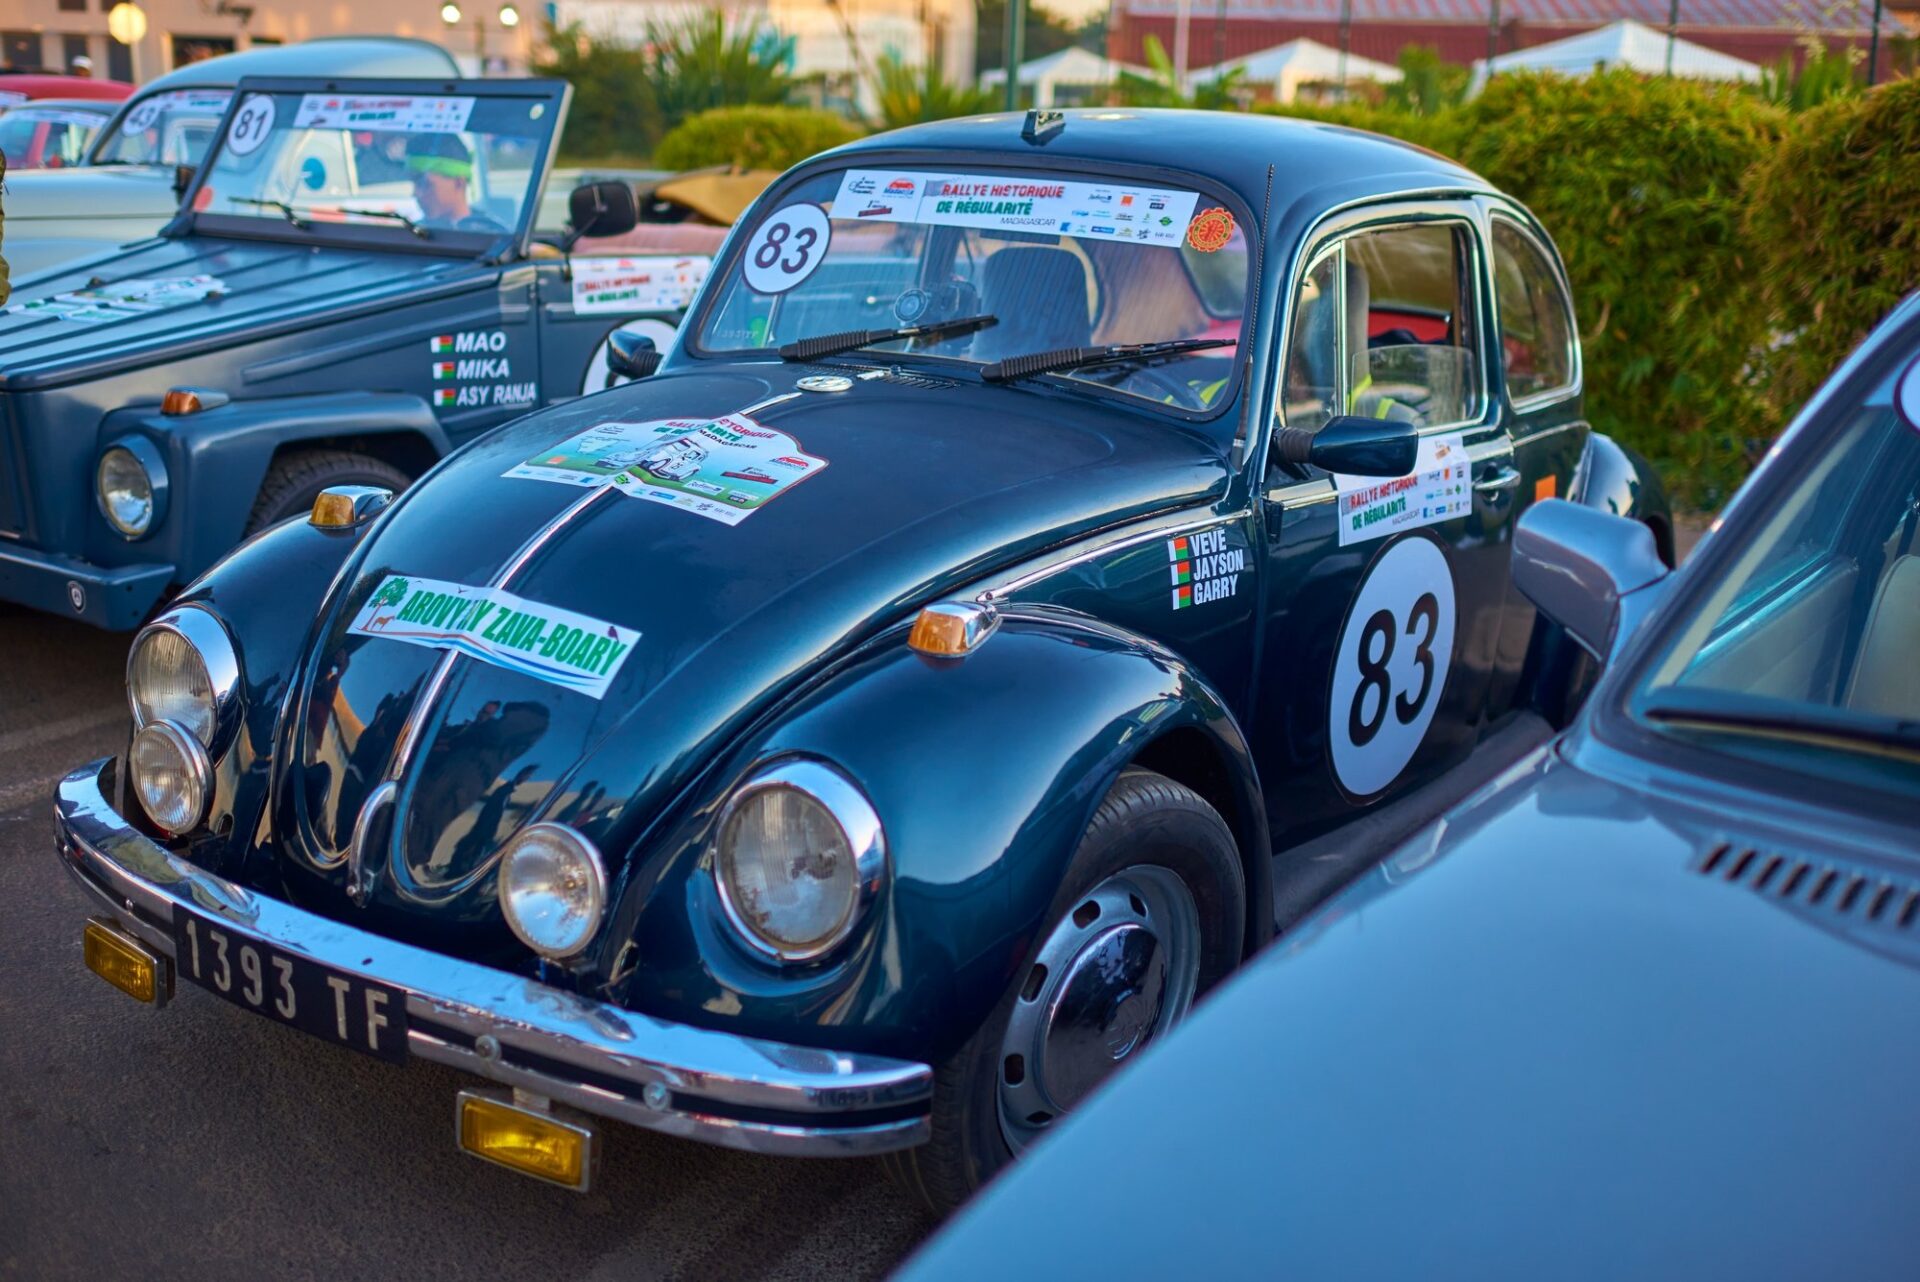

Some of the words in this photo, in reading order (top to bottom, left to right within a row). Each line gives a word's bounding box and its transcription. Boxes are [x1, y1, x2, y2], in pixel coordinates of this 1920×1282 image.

[235, 110, 267, 140] 81
[942, 184, 988, 197] RALLYE
[990, 185, 1065, 199] HISTORIQUE
[936, 200, 952, 213] DE
[955, 196, 1033, 215] RÉGULARITÉ
[1000, 216, 1056, 226] MADAGASCAR
[755, 222, 817, 274] 83
[455, 331, 506, 353] MAO
[456, 358, 510, 380] MIKA
[456, 385, 490, 406] ASY
[493, 382, 536, 404] RANJA
[1350, 486, 1378, 509] RALLYE
[1352, 512, 1363, 531] DE
[1189, 529, 1226, 557] VEVE
[1193, 549, 1244, 581] JAYSON
[1193, 573, 1238, 605] GARRY
[481, 606, 628, 676] ZAVA-BOARY
[1348, 591, 1440, 748] 83
[186, 919, 296, 1019] 1393
[327, 975, 388, 1050] TF
